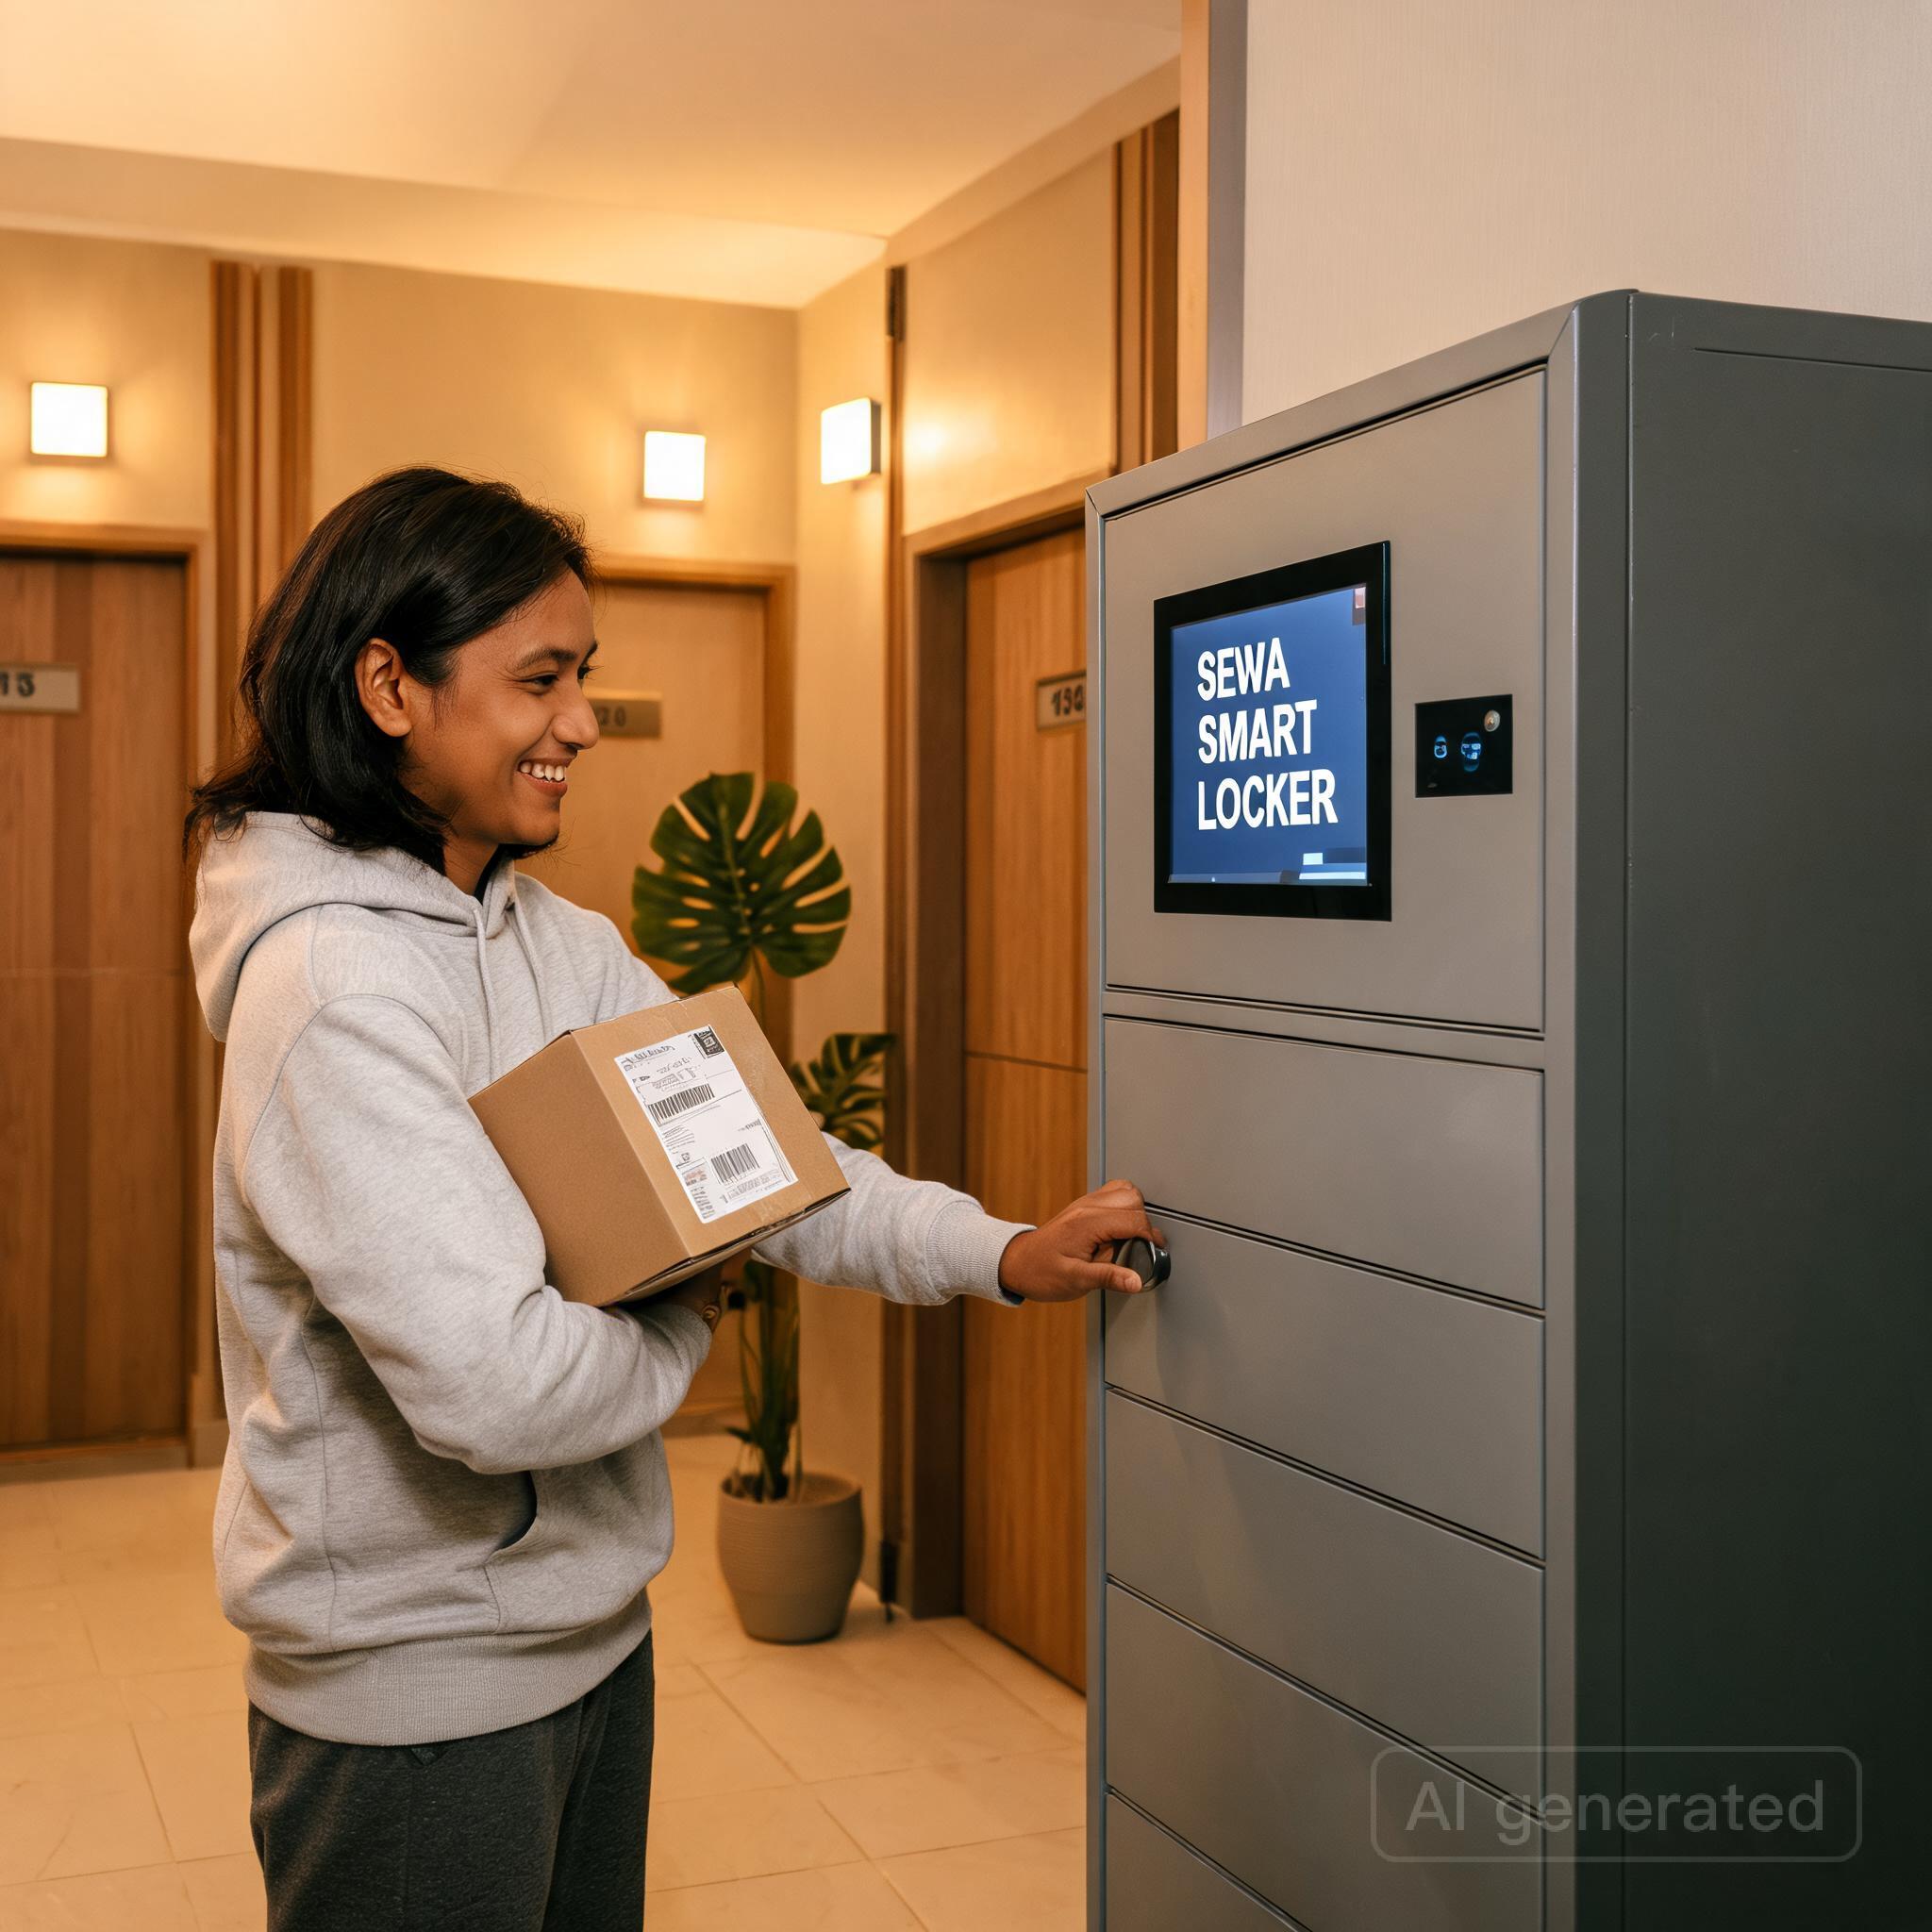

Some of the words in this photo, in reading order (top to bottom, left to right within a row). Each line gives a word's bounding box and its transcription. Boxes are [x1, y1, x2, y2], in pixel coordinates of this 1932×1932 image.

[1197, 637, 1291, 701] SEWA
[1198, 699, 1318, 764] SMART
[1198, 768, 1338, 830] LOCKER
